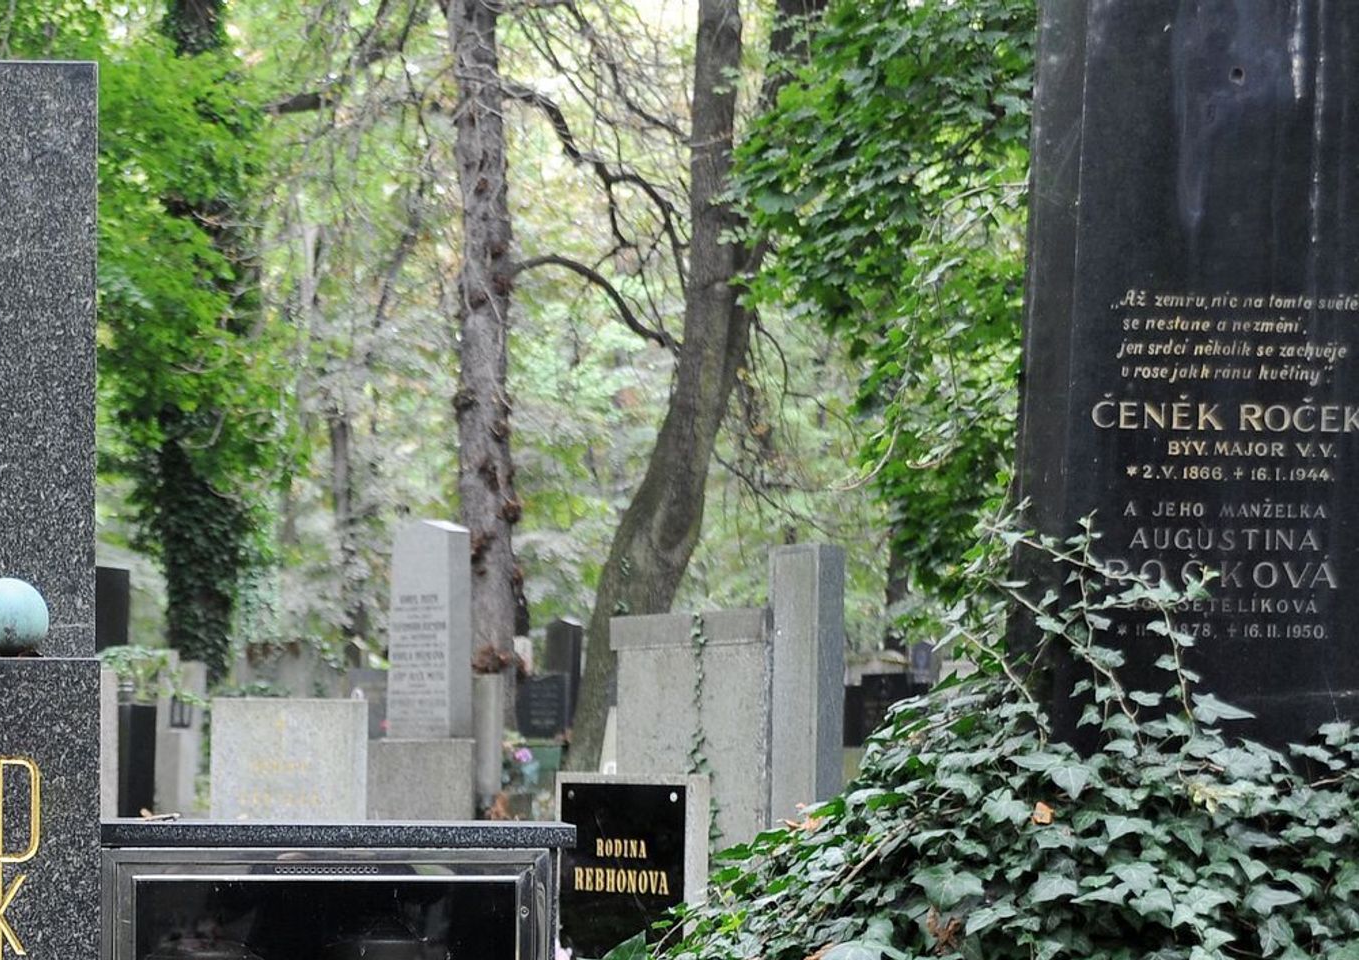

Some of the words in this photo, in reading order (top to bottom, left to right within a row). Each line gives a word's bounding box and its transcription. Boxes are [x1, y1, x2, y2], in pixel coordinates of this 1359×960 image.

[1243, 297, 1263, 308] na
[1269, 294, 1312, 310] tomto
[1123, 318, 1140, 331] se
[1145, 316, 1211, 332] nestane
[1217, 320, 1227, 332] a
[1116, 338, 1143, 359] jen
[1256, 344, 1274, 357] se
[1121, 365, 1130, 378] v
[1133, 366, 1169, 379] rose
[1199, 363, 1211, 379] k
[1091, 392, 1223, 431] ČENĚK
[1239, 397, 1359, 433] ROČEK
[1167, 436, 1209, 456] BÝV.
[1213, 441, 1285, 457] MAJOR
[1124, 501, 1137, 516] A
[1152, 502, 1205, 517] JEHO
[1219, 498, 1328, 519] MANŽELKA
[1128, 527, 1320, 551] AUGUSTINA
[596, 838, 647, 859] RODINA
[574, 867, 670, 895] REBHONOVA
